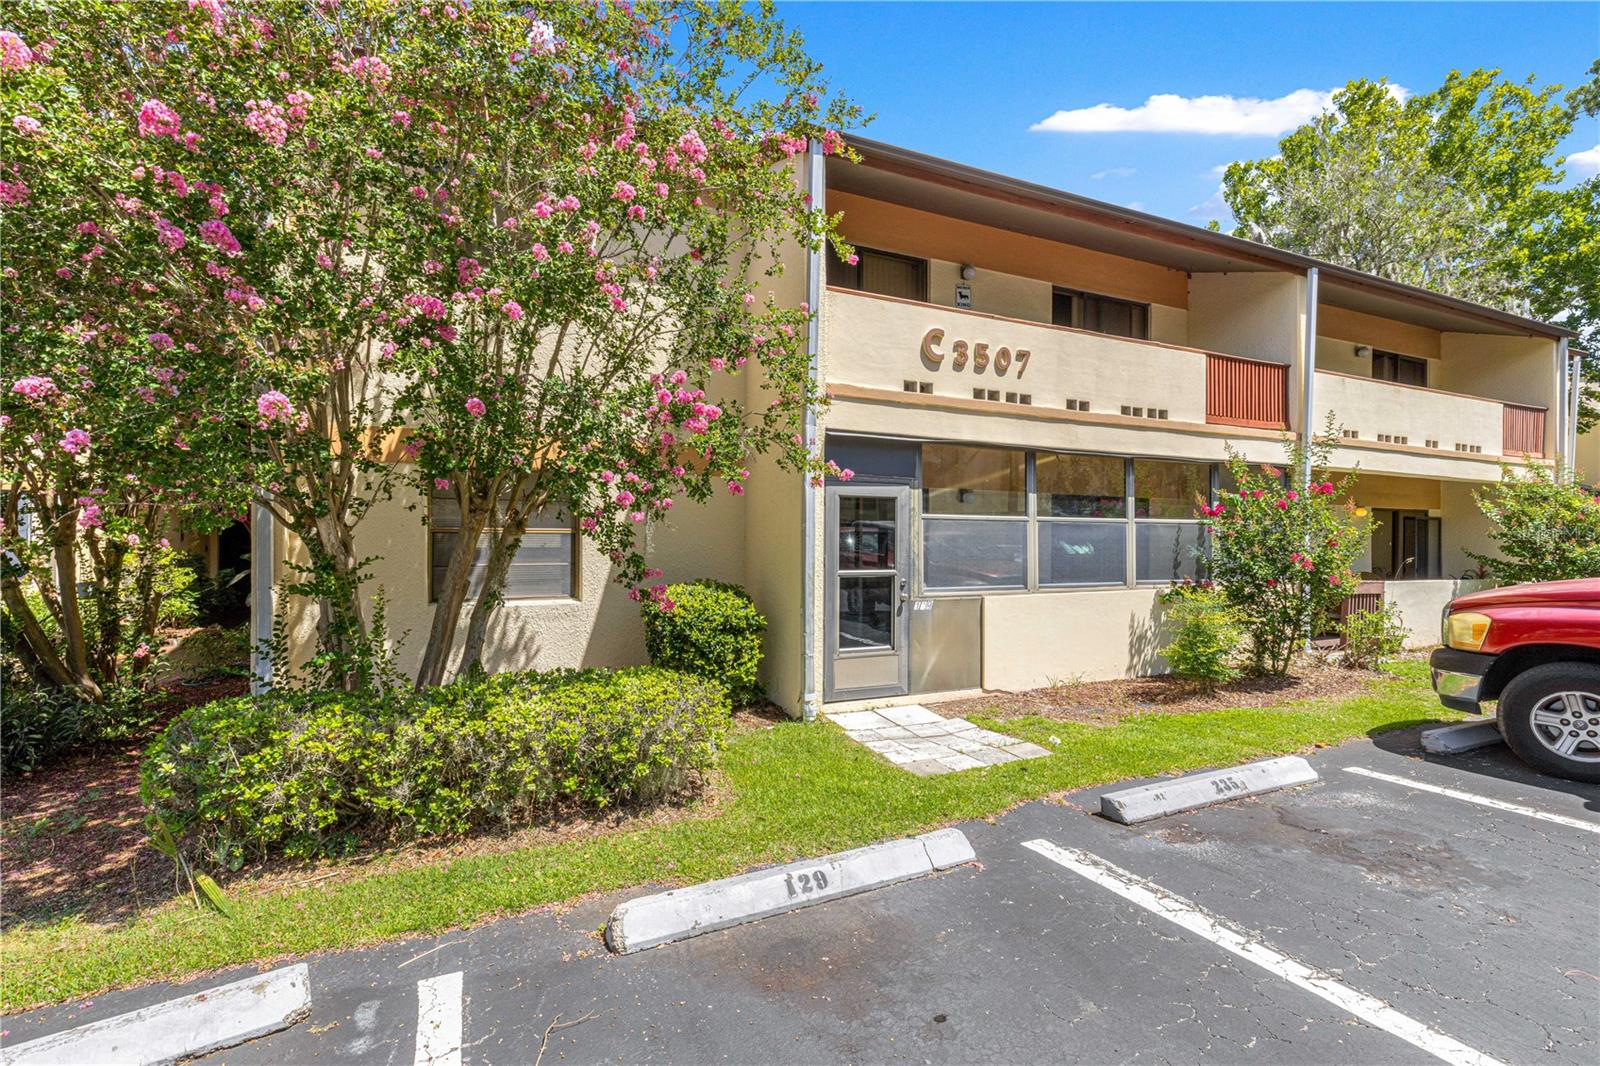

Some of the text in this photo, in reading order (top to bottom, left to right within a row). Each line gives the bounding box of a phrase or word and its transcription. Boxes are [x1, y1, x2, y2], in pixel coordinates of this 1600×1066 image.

[921, 327, 1031, 377] C 3507
[784, 869, 829, 900] 129
